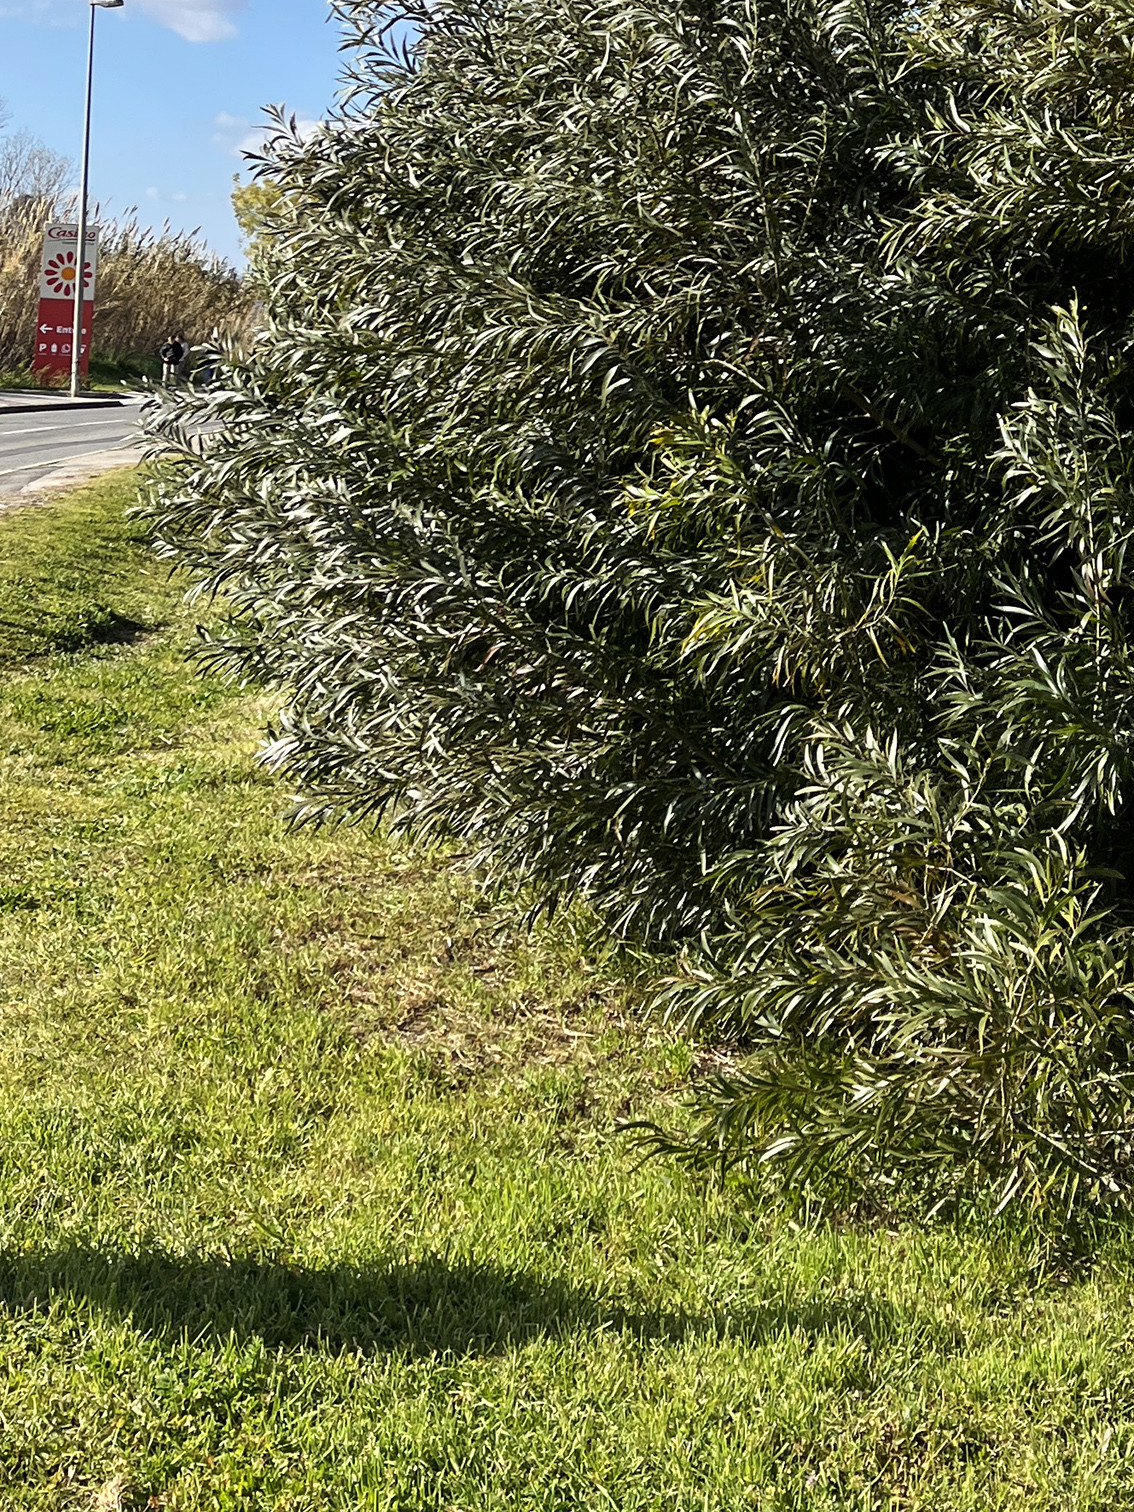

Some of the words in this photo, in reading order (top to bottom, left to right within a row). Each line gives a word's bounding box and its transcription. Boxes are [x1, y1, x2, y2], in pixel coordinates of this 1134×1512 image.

[47, 227, 96, 239] Casio
[56, 325, 87, 334] Ente
[39, 343, 47, 352] P
